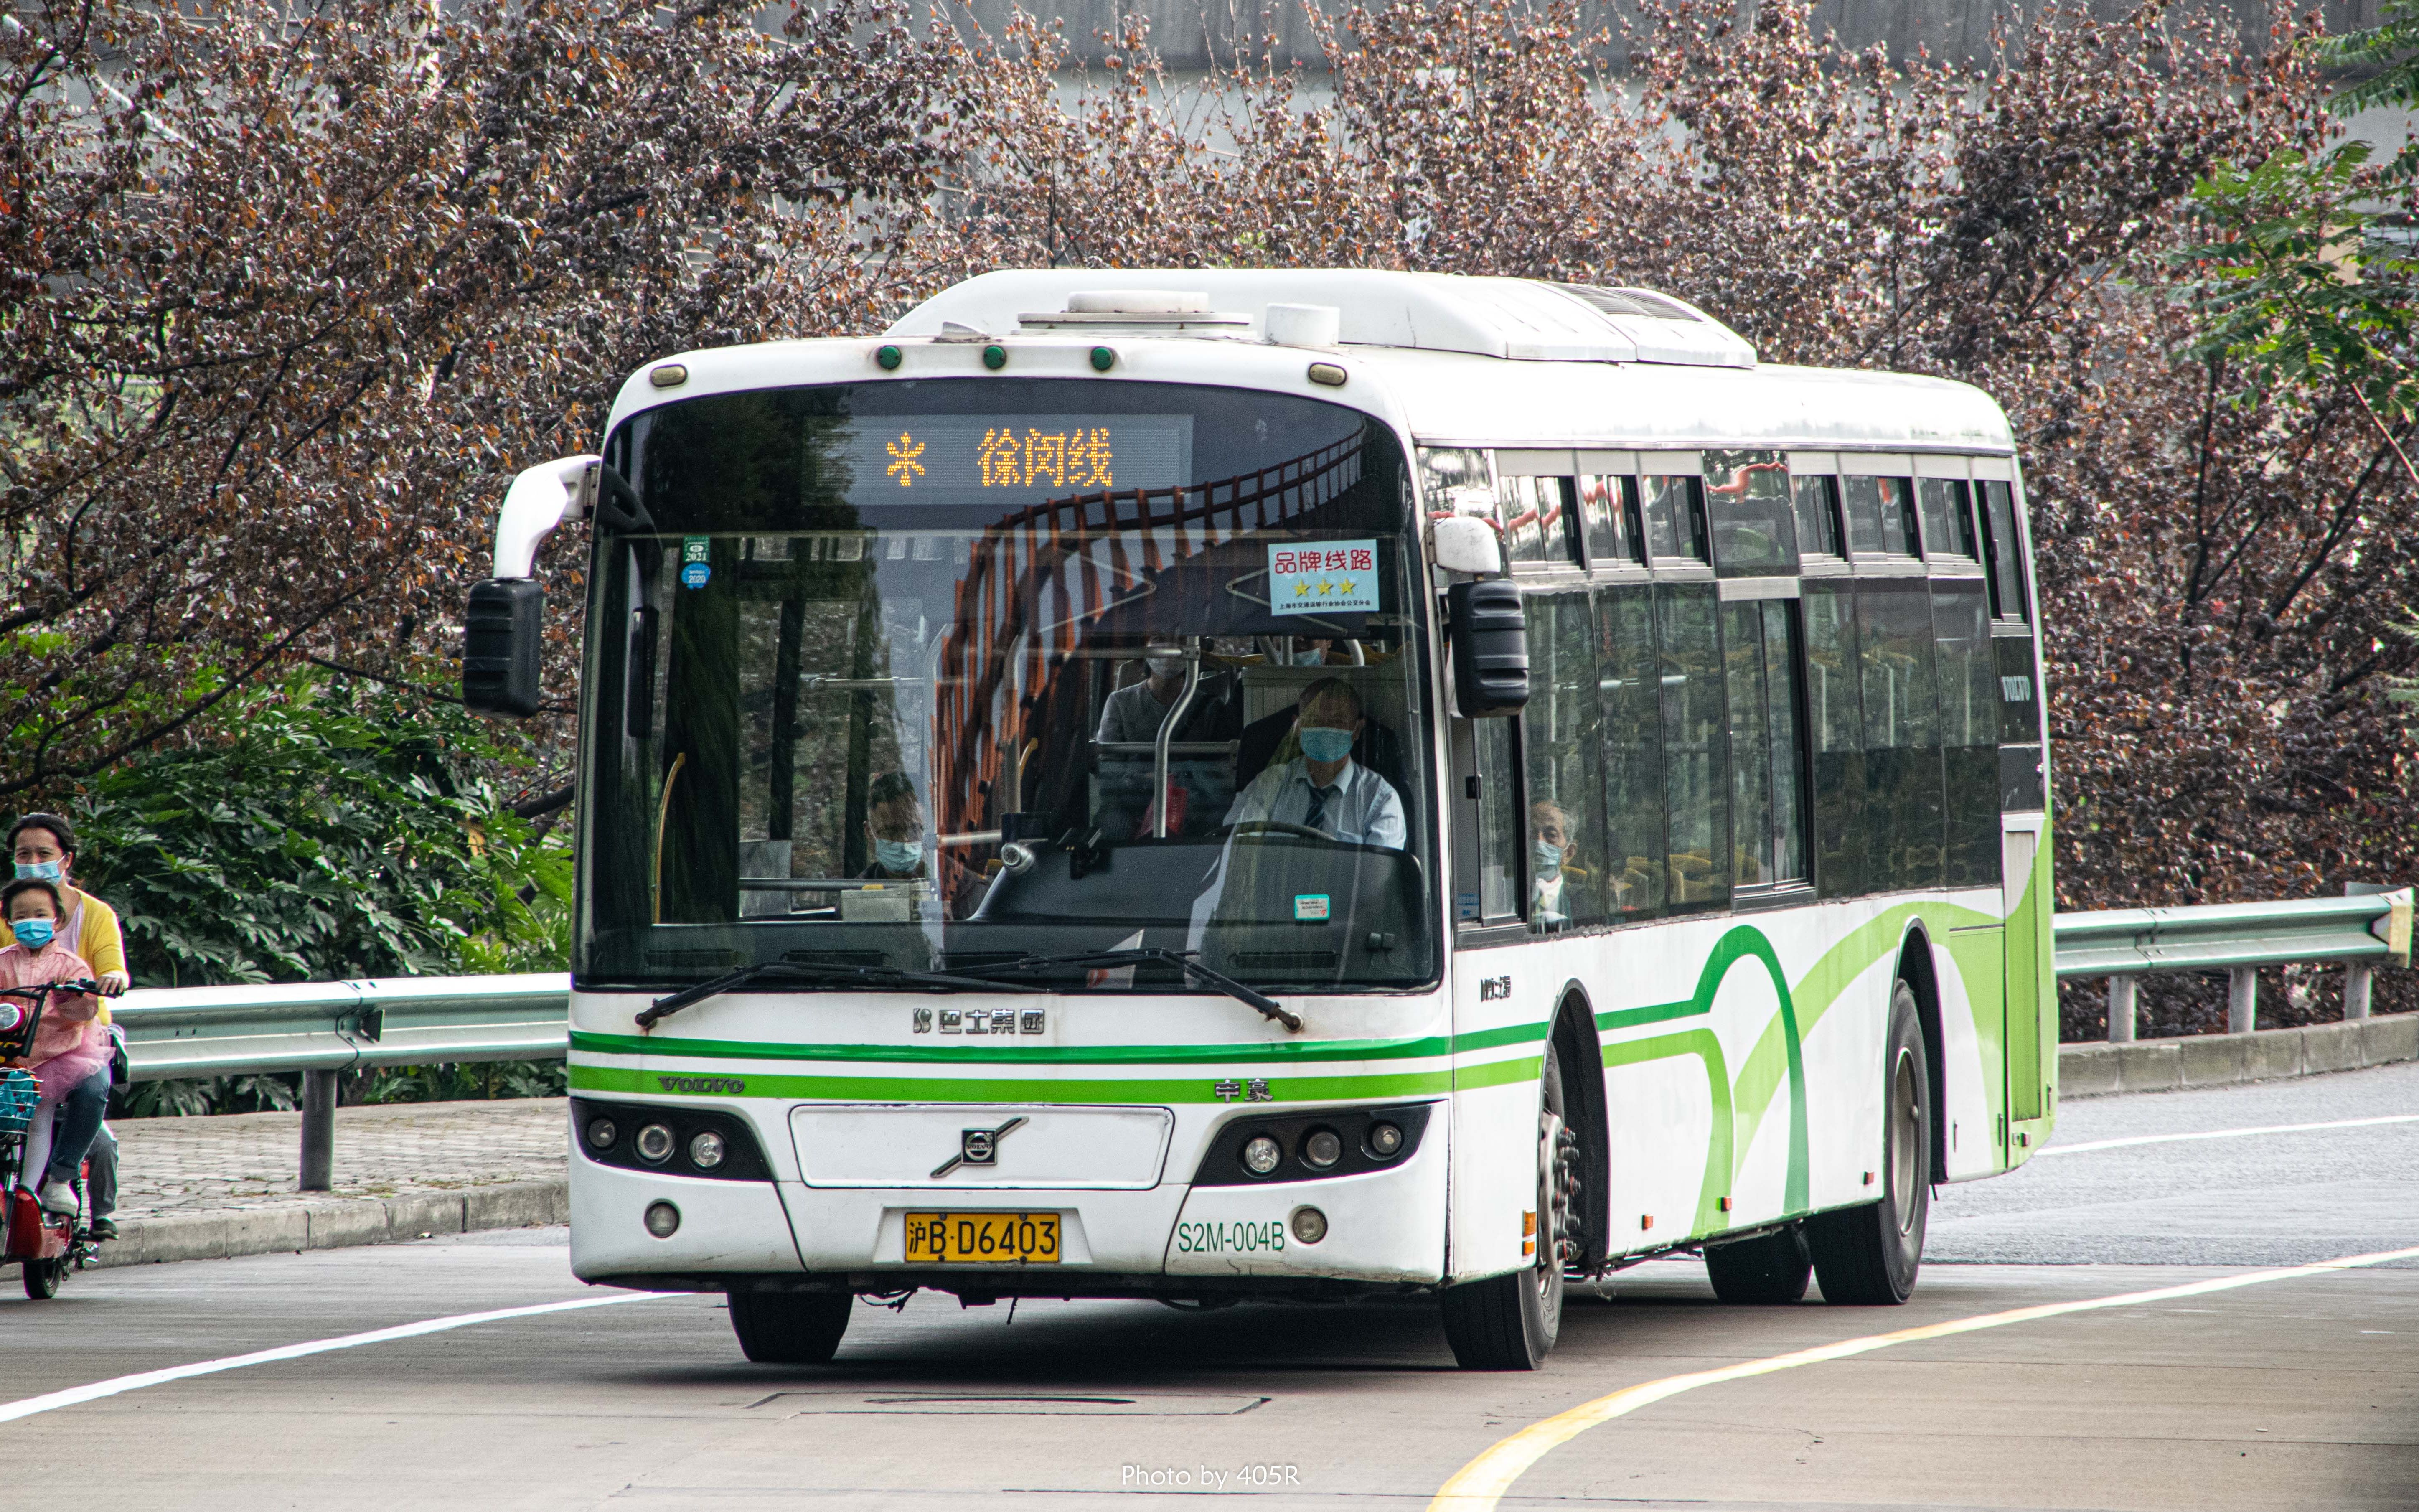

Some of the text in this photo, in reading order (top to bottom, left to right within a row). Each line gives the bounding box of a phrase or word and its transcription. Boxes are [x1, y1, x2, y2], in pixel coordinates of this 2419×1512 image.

[978, 428, 1113, 487] 徐闵线
[686, 552, 706, 561] 2021
[1275, 549, 1372, 574] 品牌线路
[1280, 599, 1371, 610] 上海市交通运输行业协会公交分会
[940, 1009, 1044, 1034] 巴士集团
[658, 1076, 745, 1093] VOLVO
[1178, 1222, 1285, 1253] S2M-004B
